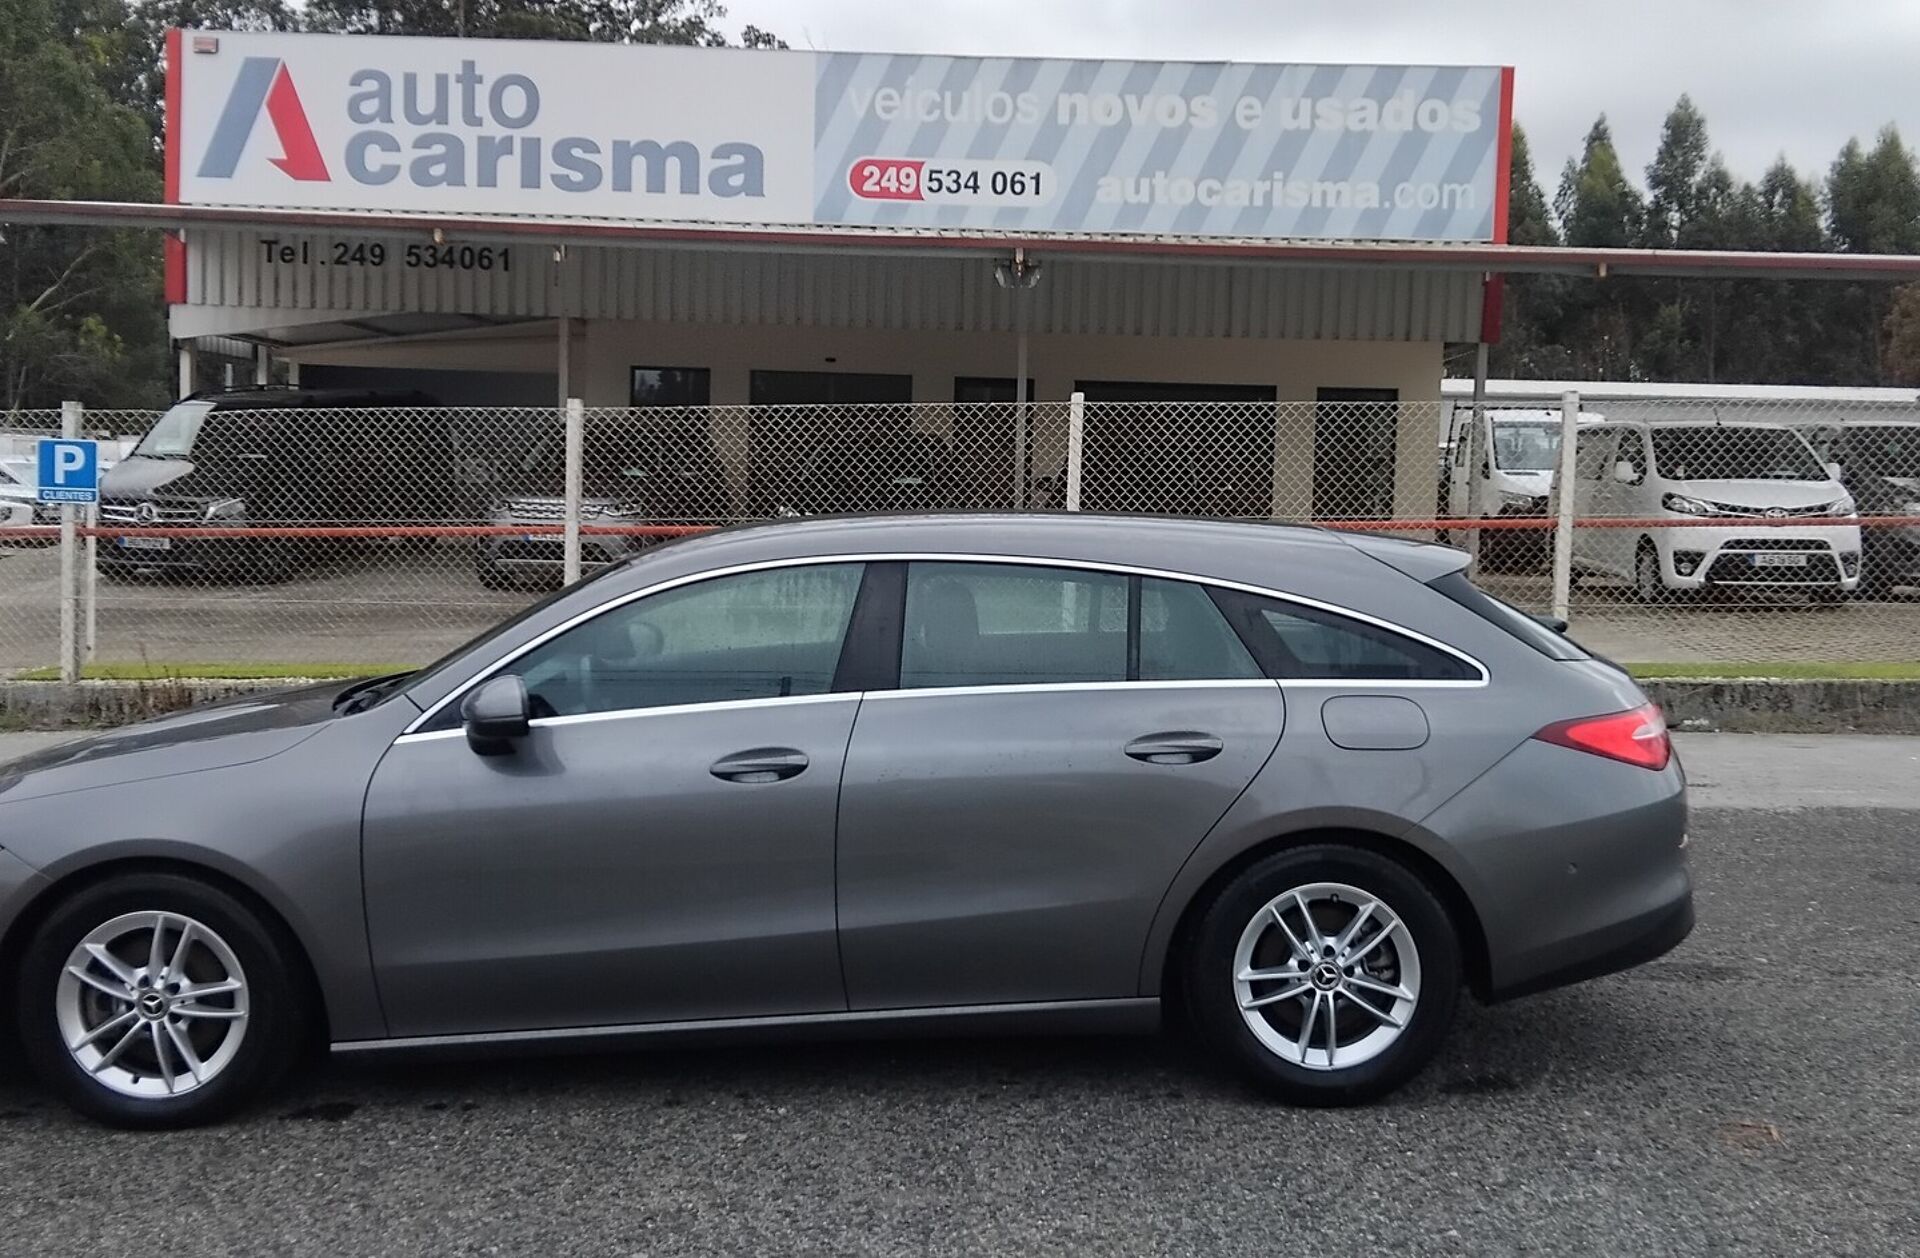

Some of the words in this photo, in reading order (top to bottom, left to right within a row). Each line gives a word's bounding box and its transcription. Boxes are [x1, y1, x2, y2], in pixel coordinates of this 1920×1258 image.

[347, 60, 540, 129] auto
[848, 74, 1039, 124] veículos
[1056, 91, 1219, 129] novos
[1235, 95, 1262, 129] e
[1280, 90, 1482, 133] usados
[344, 130, 765, 197] carisma
[862, 165, 917, 194] 249
[926, 169, 980, 195] 534
[990, 171, 1041, 196] 061
[1096, 170, 1475, 210] autocarisma.com
[405, 244, 510, 272] 534061
[54, 444, 86, 484] P
[42, 490, 93, 501] CLIENTES
